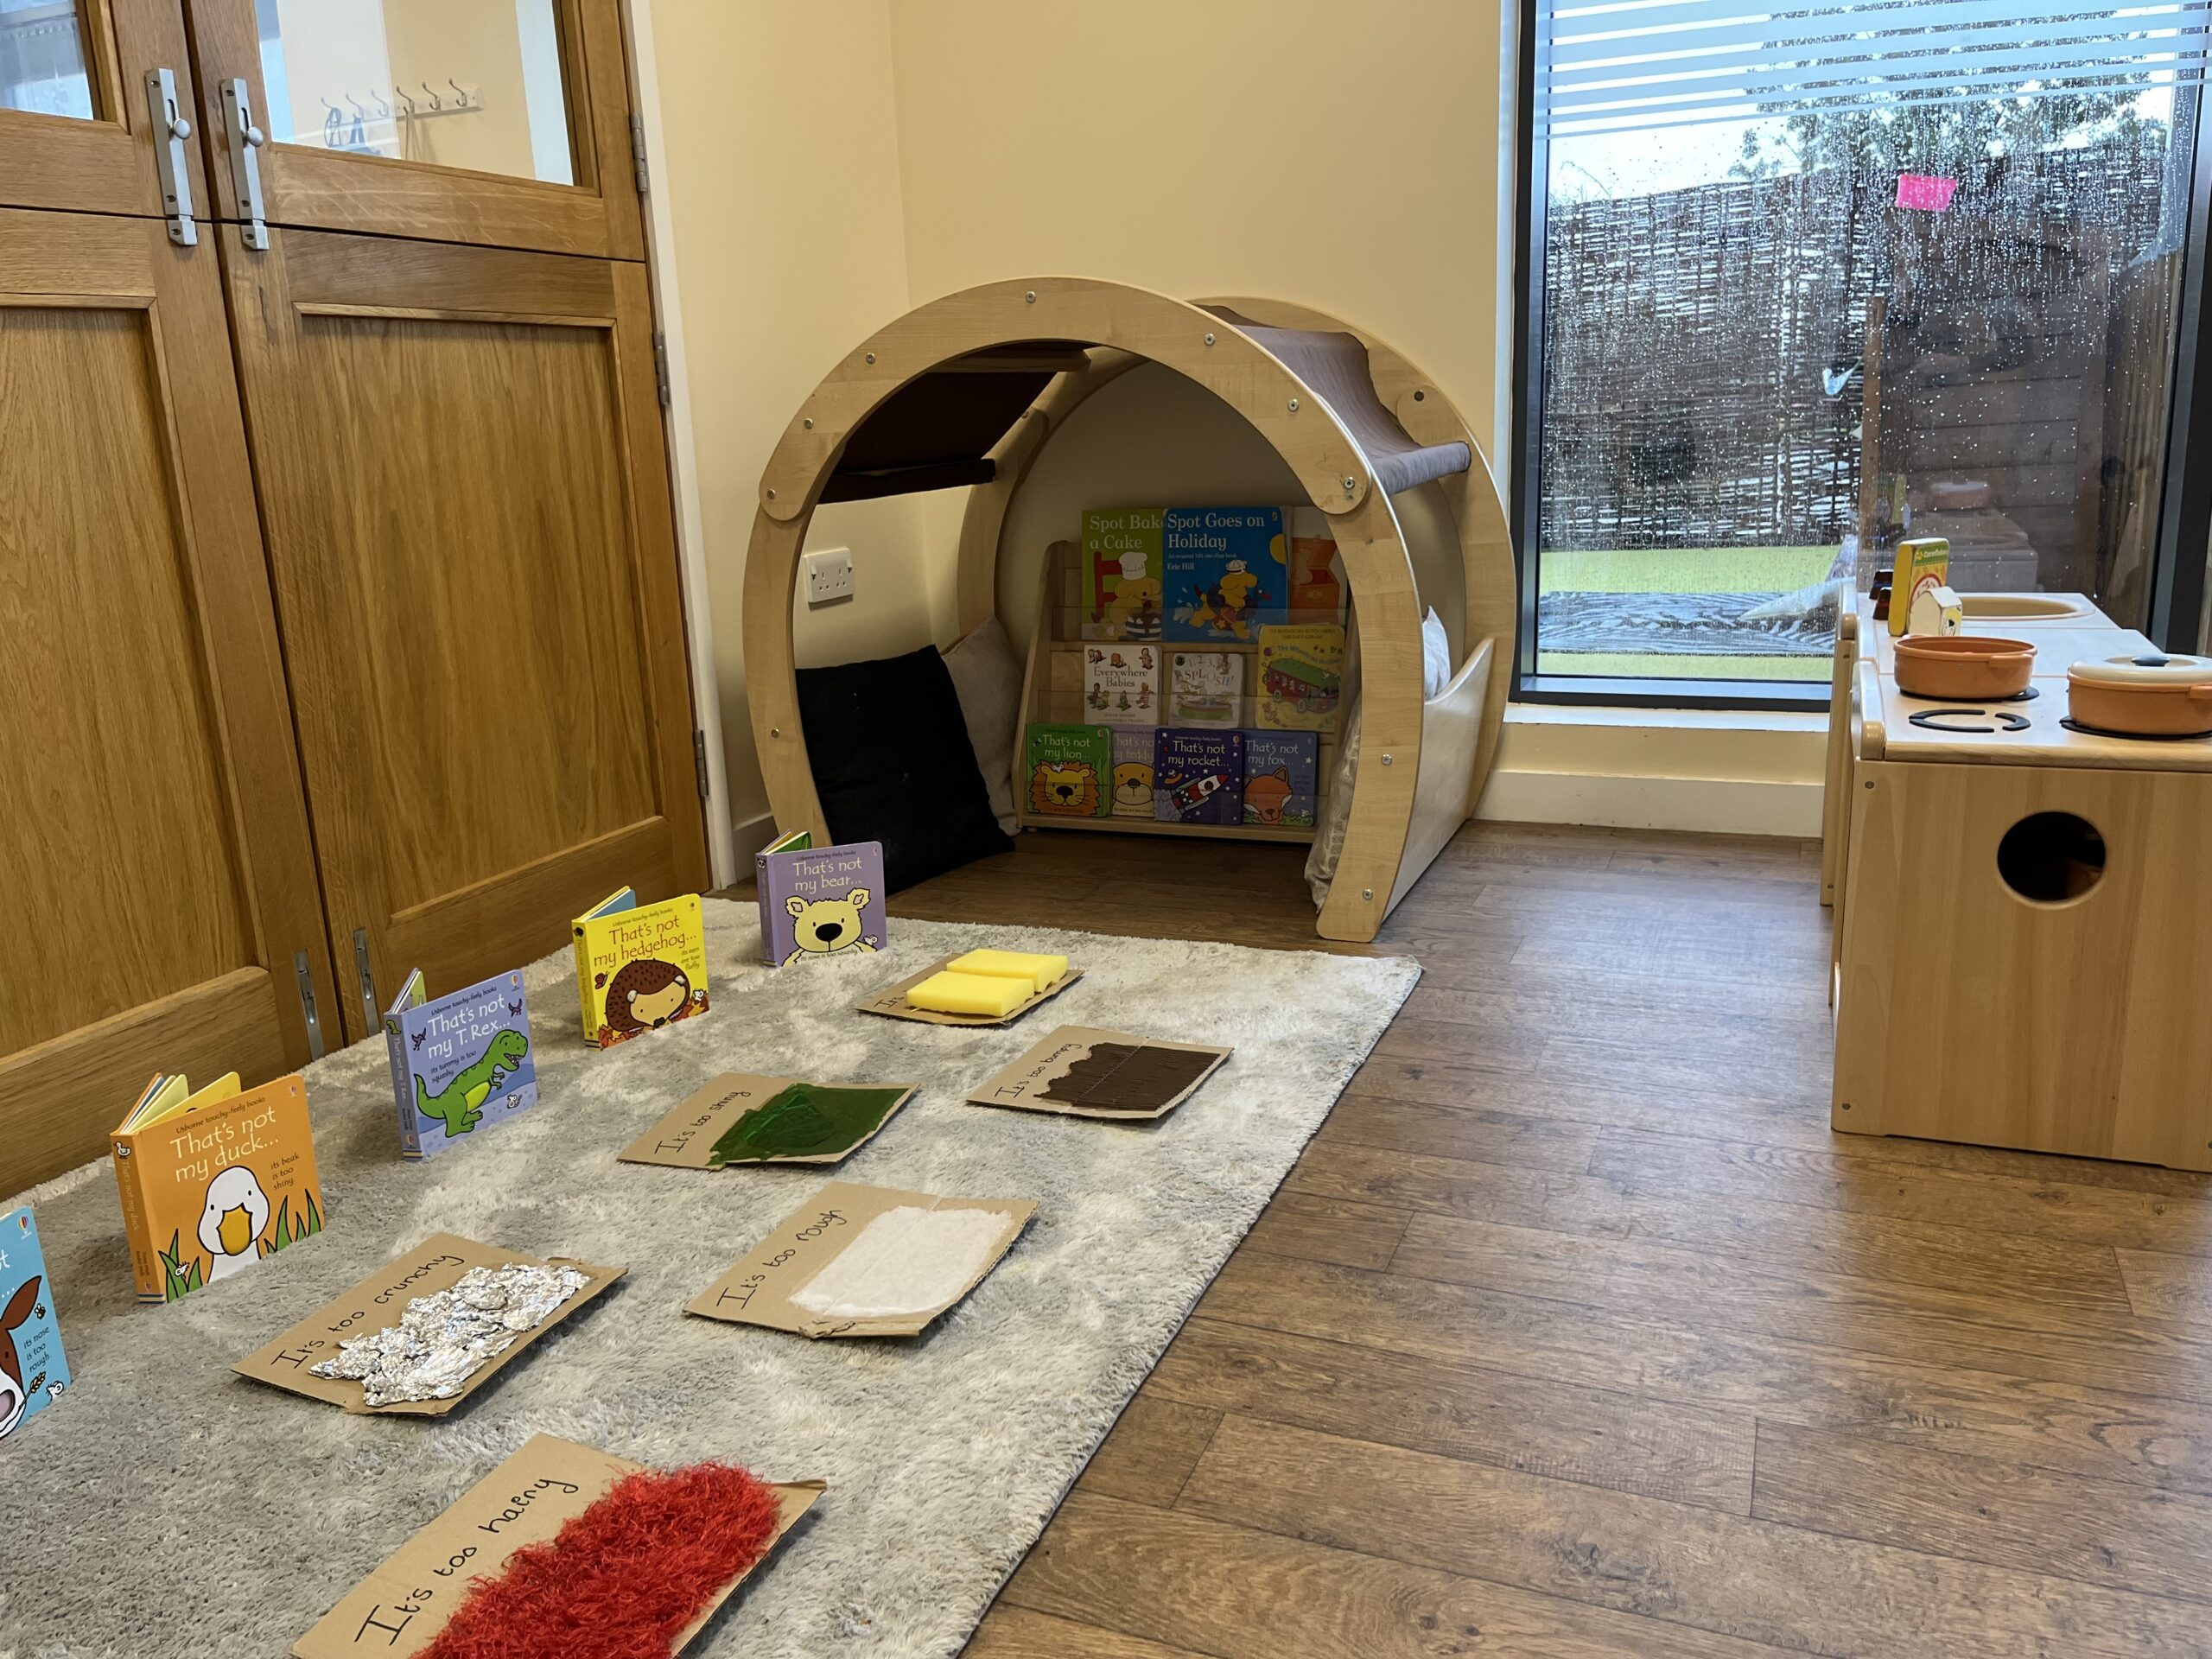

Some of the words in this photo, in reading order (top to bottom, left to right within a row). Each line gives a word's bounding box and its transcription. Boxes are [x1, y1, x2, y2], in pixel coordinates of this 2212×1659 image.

[1090, 516, 1125, 532] Spot
[1167, 513, 1200, 531] Spot
[1205, 513, 1242, 528] Goes
[1247, 516, 1265, 527] on
[1090, 539, 1098, 549] a
[1104, 535, 1142, 549] Cake
[1167, 533, 1226, 551] Holiday
[1094, 665, 1148, 679] Everywhere
[1185, 669, 1235, 686] SPLOSH!
[1106, 677, 1135, 688] Babies
[1042, 734, 1071, 747] That's
[1073, 738, 1090, 747] not
[1114, 734, 1139, 747] hat's
[1173, 741, 1203, 753] That's
[1207, 744, 1225, 754] not
[1244, 740, 1276, 753] That's
[1280, 743, 1299, 753] not
[1045, 749, 1060, 760] my
[1064, 747, 1090, 760] lion...
[1168, 756, 1184, 767] my
[1188, 754, 1229, 766] rocket...
[1248, 756, 1264, 767] my
[791, 860, 834, 876] That's
[839, 856, 862, 871] not
[795, 880, 817, 894] my
[821, 874, 861, 888] bear...
[608, 923, 652, 945] That's
[656, 915, 680, 933] not
[594, 952, 617, 969] my
[620, 933, 696, 960] hedgehog...
[431, 1004, 451, 1016] Usborne
[452, 992, 482, 1007] touchy-feely
[483, 987, 497, 995] books
[427, 1007, 475, 1037] That's
[479, 994, 505, 1018] not
[428, 1039, 453, 1059] my
[455, 1028, 468, 1046] T.
[470, 1020, 511, 1041] Rex...
[430, 1065, 439, 1075] its
[439, 1058, 460, 1071] tummy
[431, 1069, 454, 1084] squashy
[995, 1080, 1029, 1098] It's
[1026, 1066, 1046, 1077] too
[176, 1120, 205, 1134] Usborne
[205, 1103, 246, 1123] touchy-feely
[246, 1096, 266, 1109] books
[654, 1130, 696, 1154] It's
[690, 1115, 712, 1127] too
[709, 1091, 752, 1111] shiny
[169, 1122, 235, 1159] That's
[241, 1106, 276, 1135] not
[175, 1159, 209, 1183] my
[215, 1133, 279, 1166] duck...
[270, 1162, 280, 1171] its
[282, 1153, 300, 1166] beak
[280, 1167, 294, 1177] too
[274, 1178, 294, 1191] shiny
[716, 1274, 766, 1310] It's
[762, 1249, 796, 1267] too
[796, 1210, 848, 1241] rough
[270, 1340, 325, 1370] It's
[328, 1310, 365, 1332] too
[374, 1255, 465, 1305] crunchy
[23, 1339, 33, 1350] its
[33, 1326, 50, 1340] nose
[26, 1352, 33, 1362] is
[33, 1343, 46, 1355] too
[29, 1351, 52, 1373] rough.
[354, 1588, 433, 1646] It's
[433, 1547, 477, 1577] too
[478, 1478, 580, 1534] hairy
